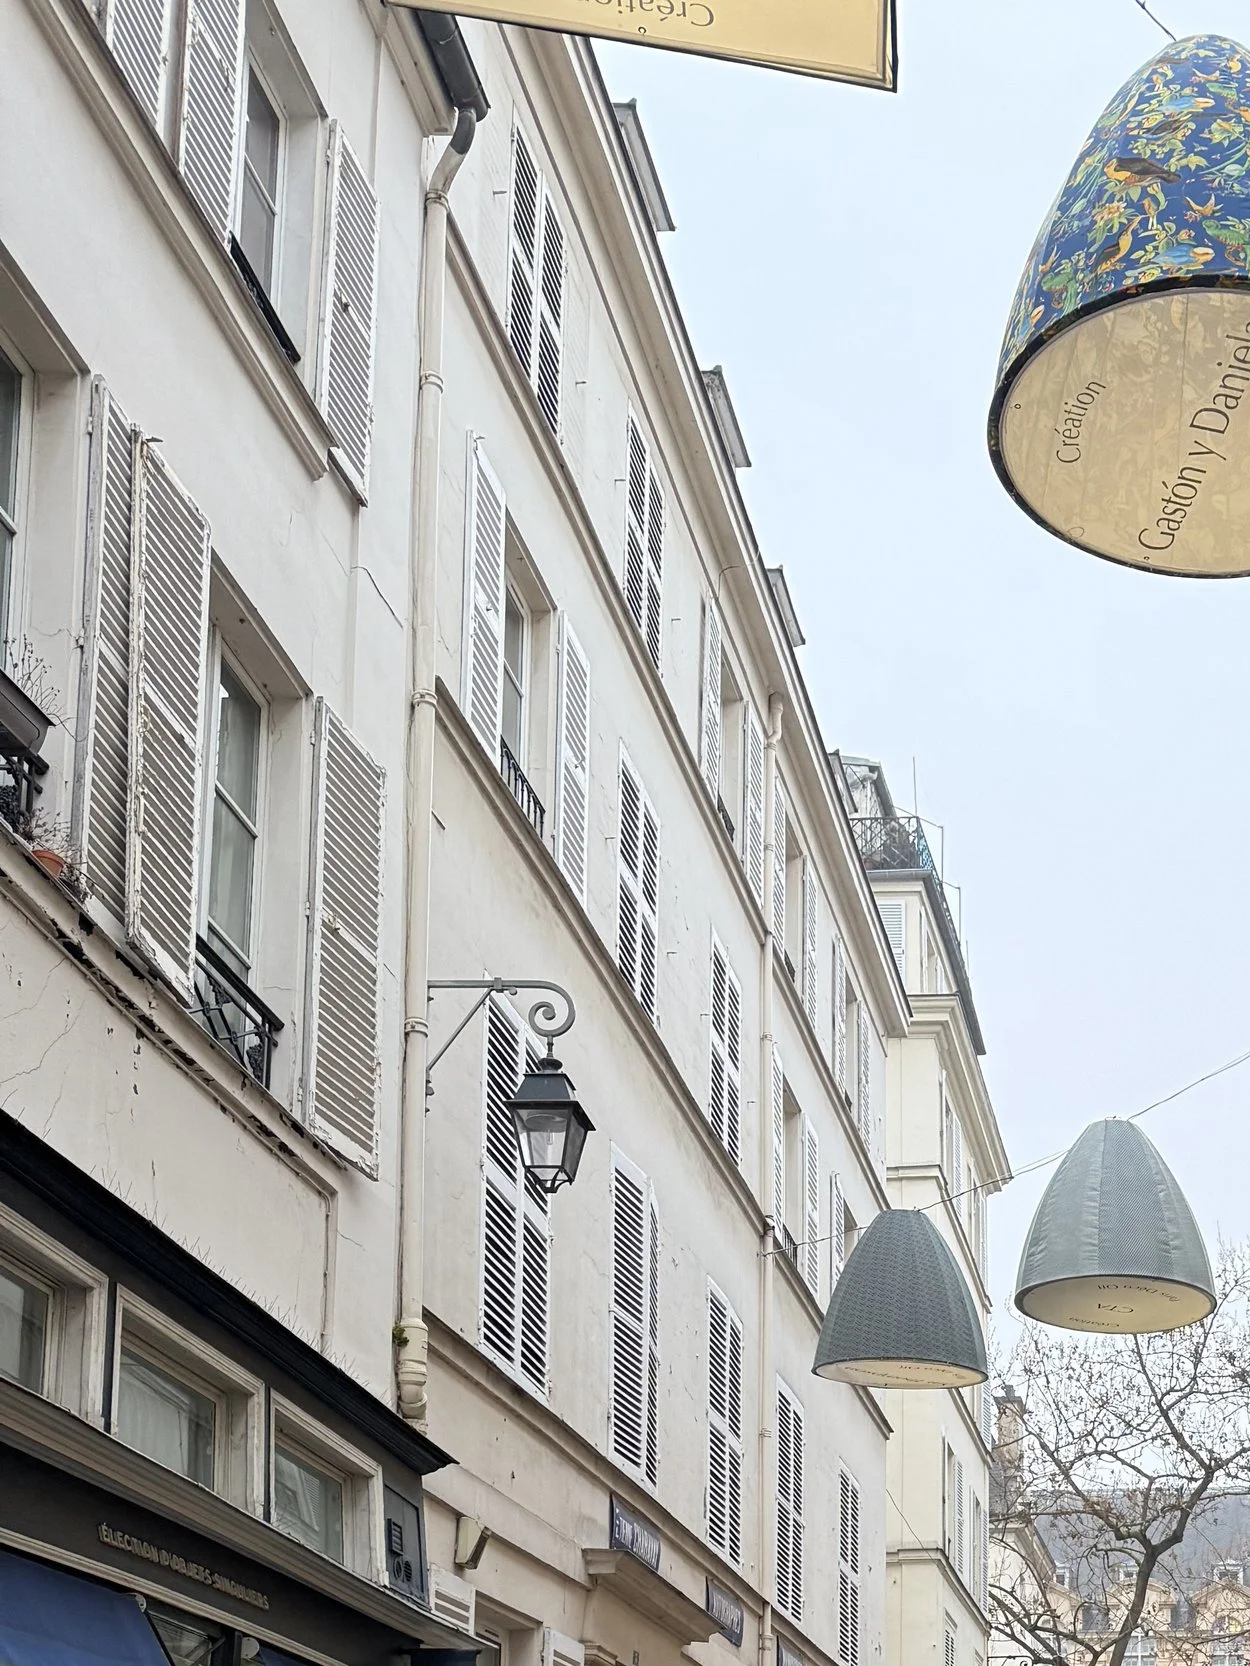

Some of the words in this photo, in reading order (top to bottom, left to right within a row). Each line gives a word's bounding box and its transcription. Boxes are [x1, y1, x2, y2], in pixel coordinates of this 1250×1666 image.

[583, 0, 714, 27] Créati
[1056, 380, 1107, 464] Création
[1139, 465, 1207, 551] Gastón
[1188, 440, 1227, 461] y
